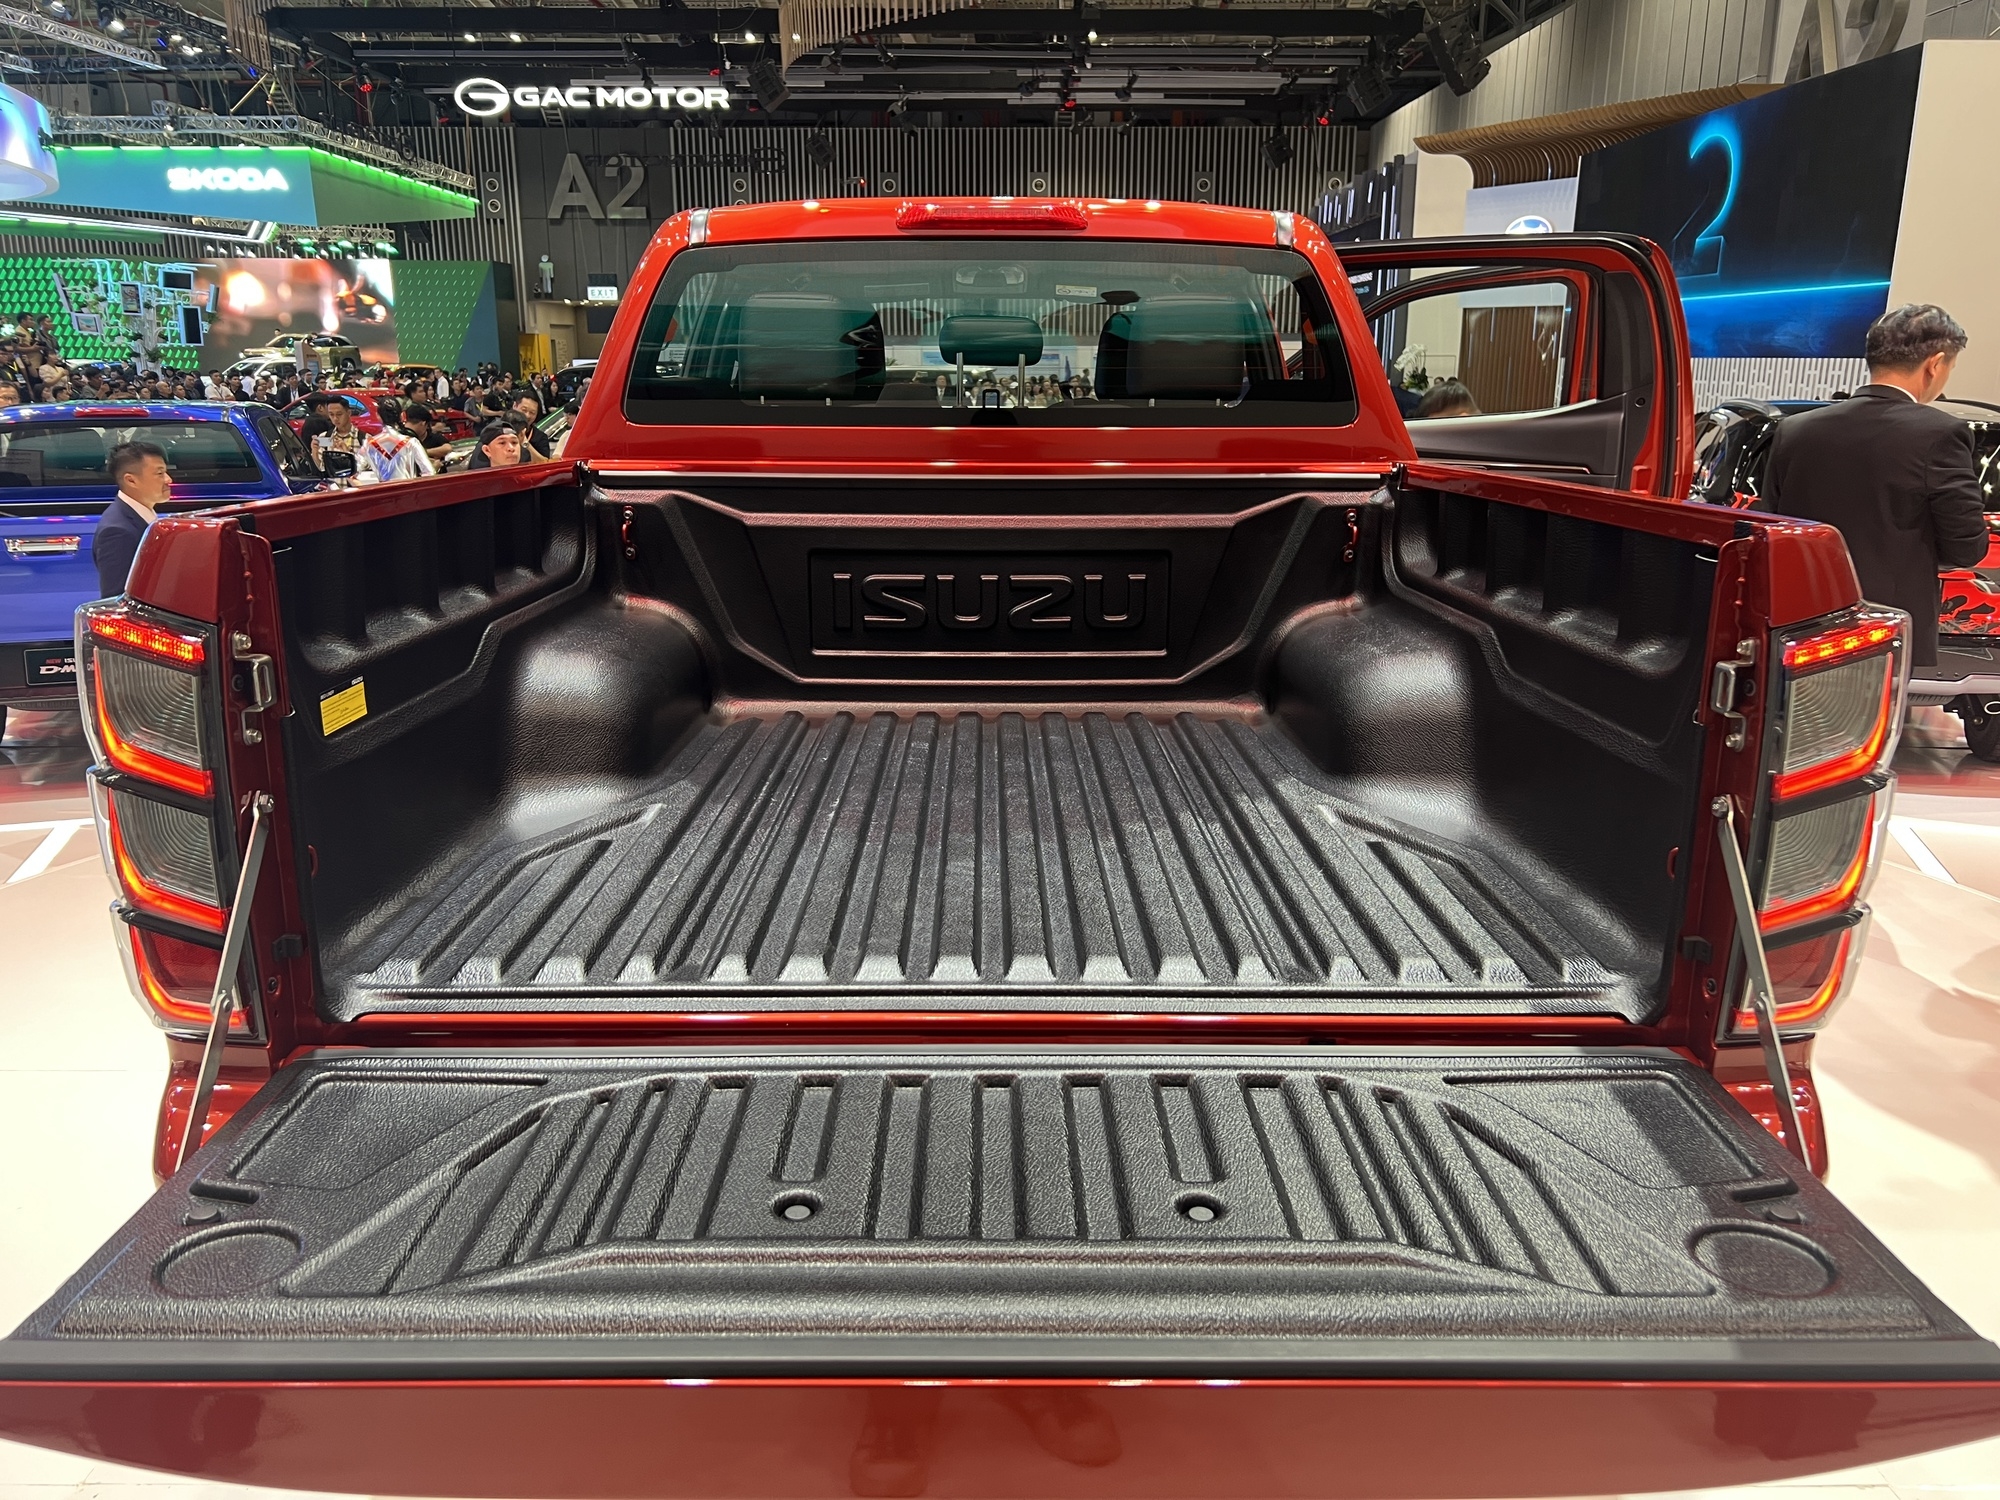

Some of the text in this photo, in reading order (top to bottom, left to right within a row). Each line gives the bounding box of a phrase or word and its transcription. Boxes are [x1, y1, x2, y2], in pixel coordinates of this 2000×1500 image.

[514, 86, 730, 109] GAC MOTOR
[548, 153, 648, 219] A2
[590, 289, 614, 297] EXIT
[833, 573, 1147, 630] ISUZU
